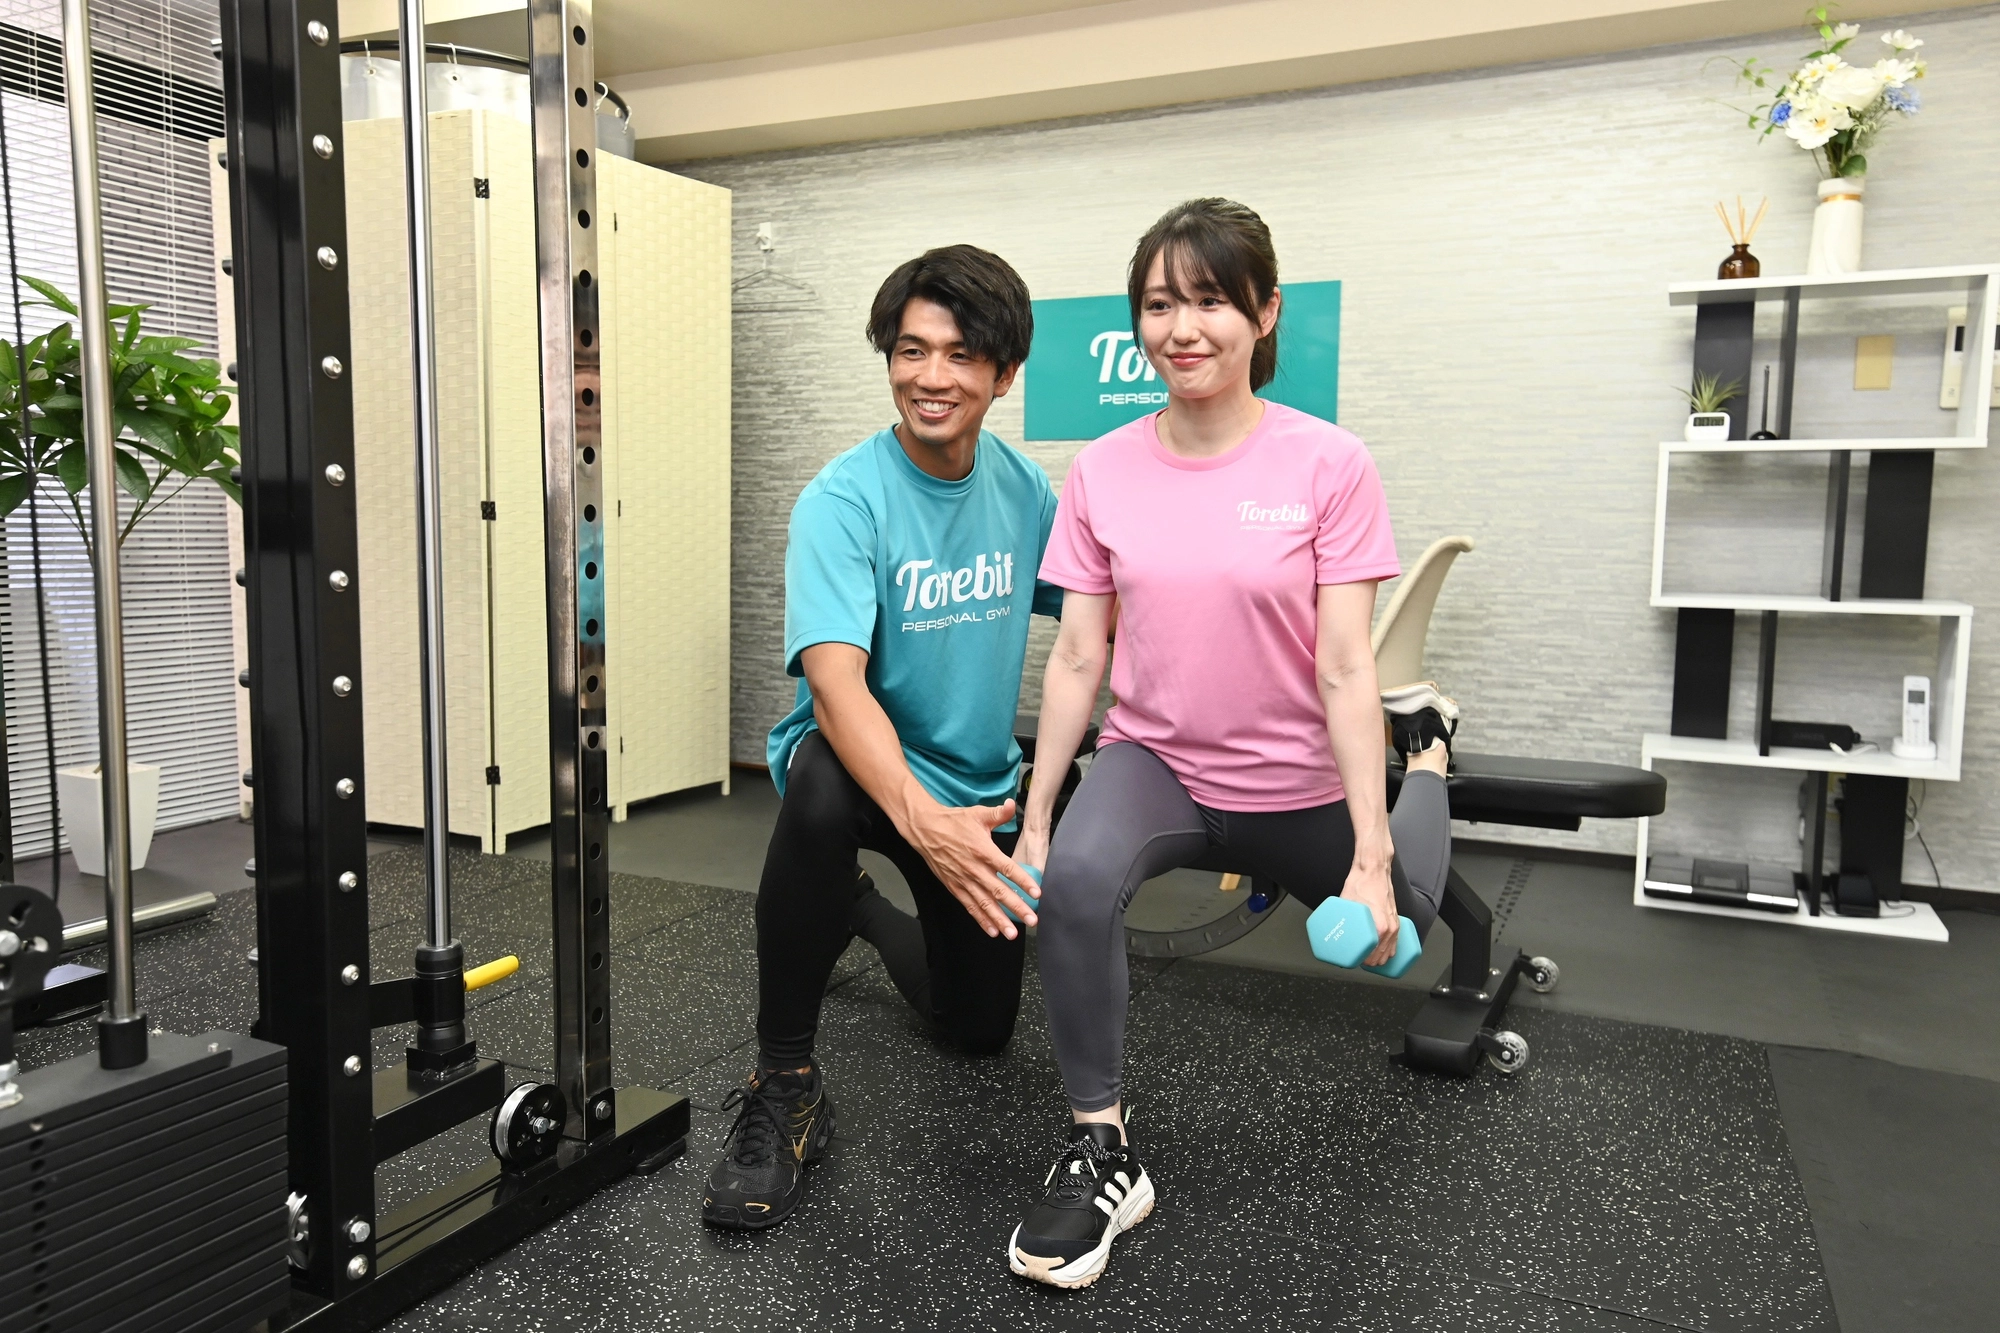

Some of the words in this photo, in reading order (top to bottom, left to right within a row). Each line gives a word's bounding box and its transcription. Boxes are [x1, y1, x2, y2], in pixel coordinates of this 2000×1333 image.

[1099, 392, 1169, 405] PERSO
[1237, 500, 1310, 522] Torebit
[896, 550, 1014, 612] Torebit
[902, 612, 982, 632] PERSONAL
[986, 606, 1011, 621] GYM
